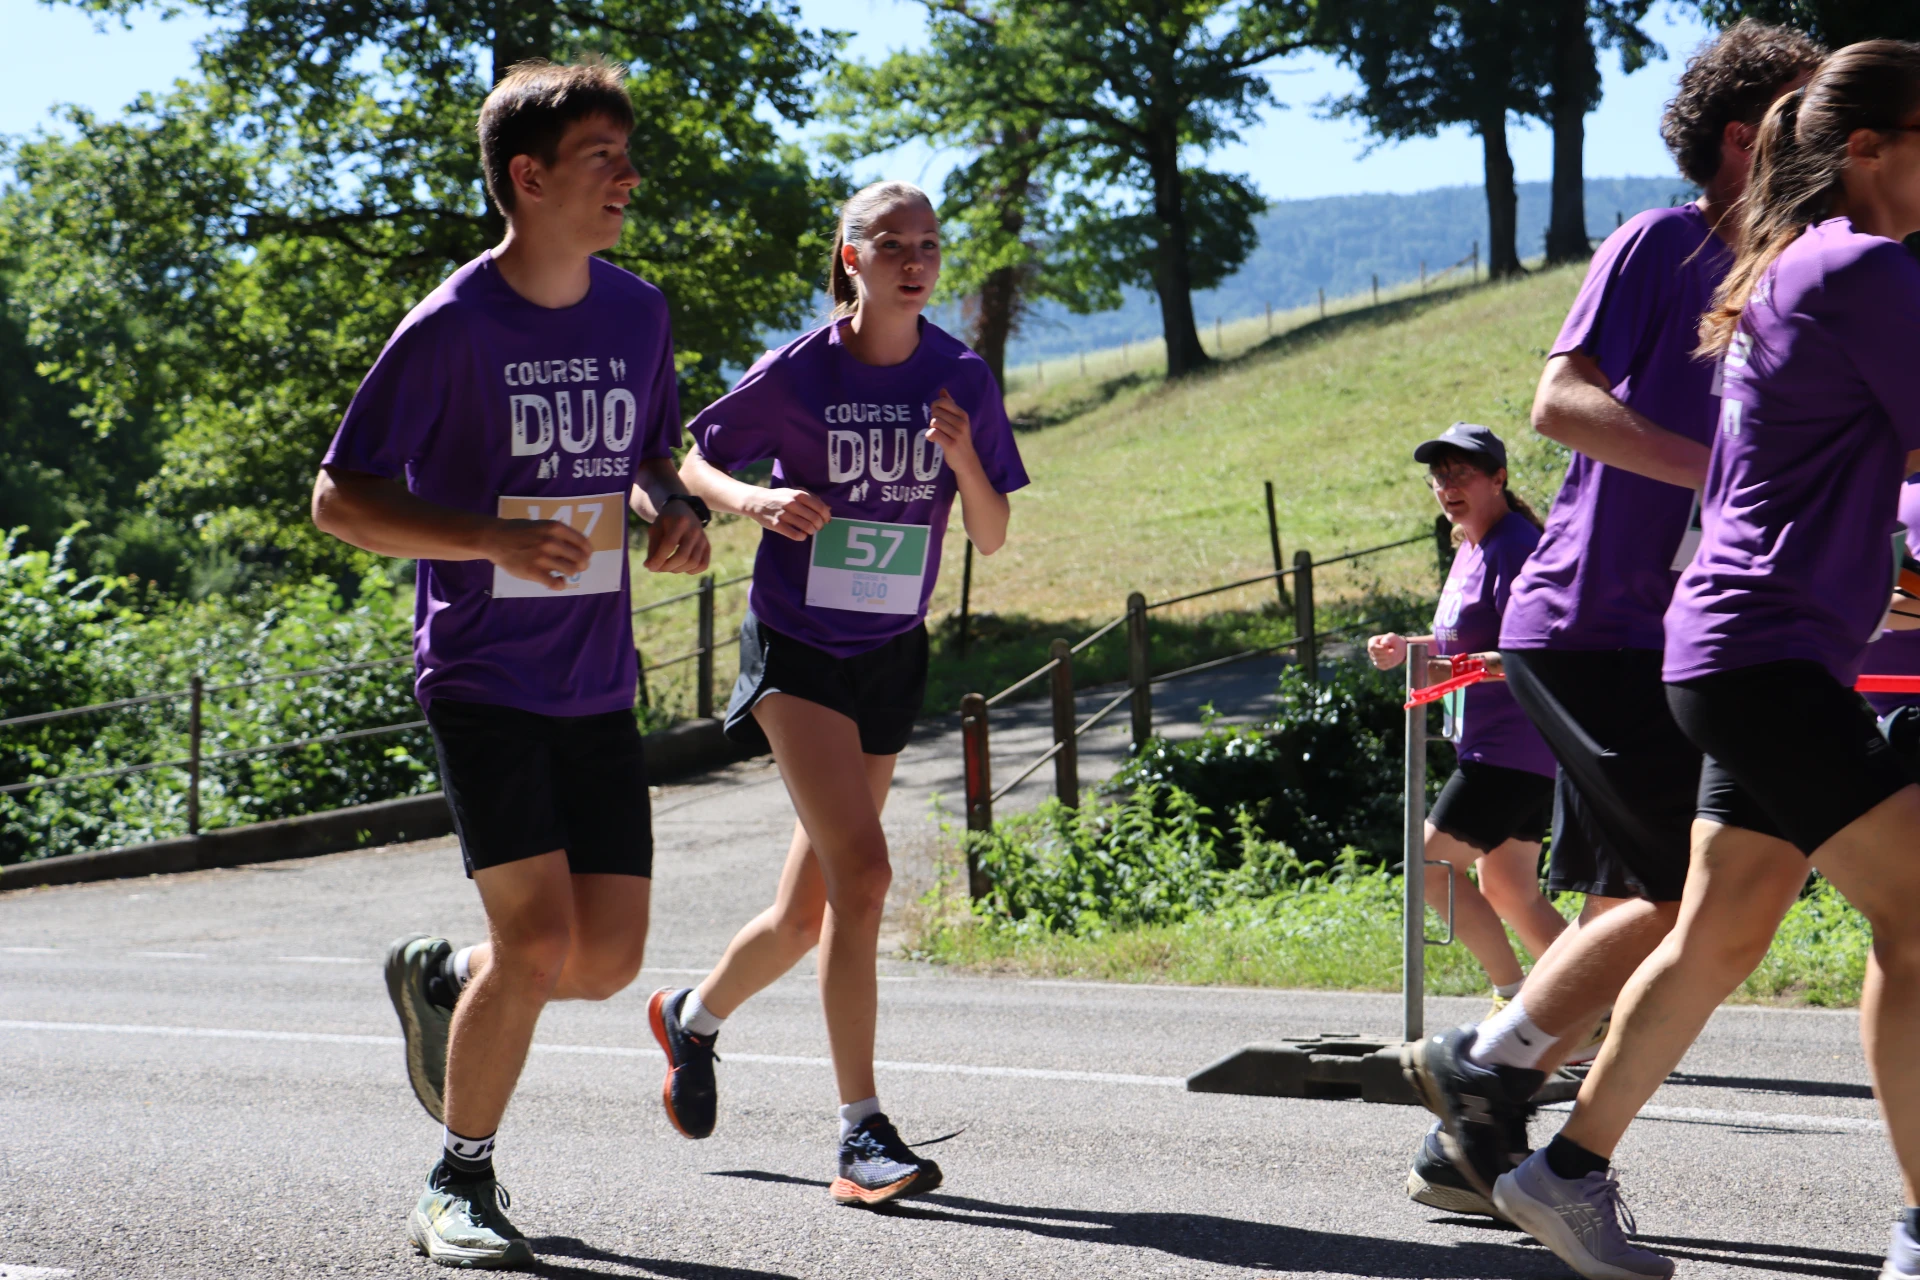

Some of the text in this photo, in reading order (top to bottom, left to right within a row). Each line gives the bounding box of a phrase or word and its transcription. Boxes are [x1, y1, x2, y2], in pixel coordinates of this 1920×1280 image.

[504, 358, 600, 386] COURSE
[509, 388, 637, 457] DUO
[824, 402, 912, 424] COURSE
[572, 457, 630, 478] SUISSE
[827, 428, 944, 483] DUO
[881, 484, 937, 502] SUISSE
[844, 525, 905, 569] 57
[851, 580, 888, 598] DUO
